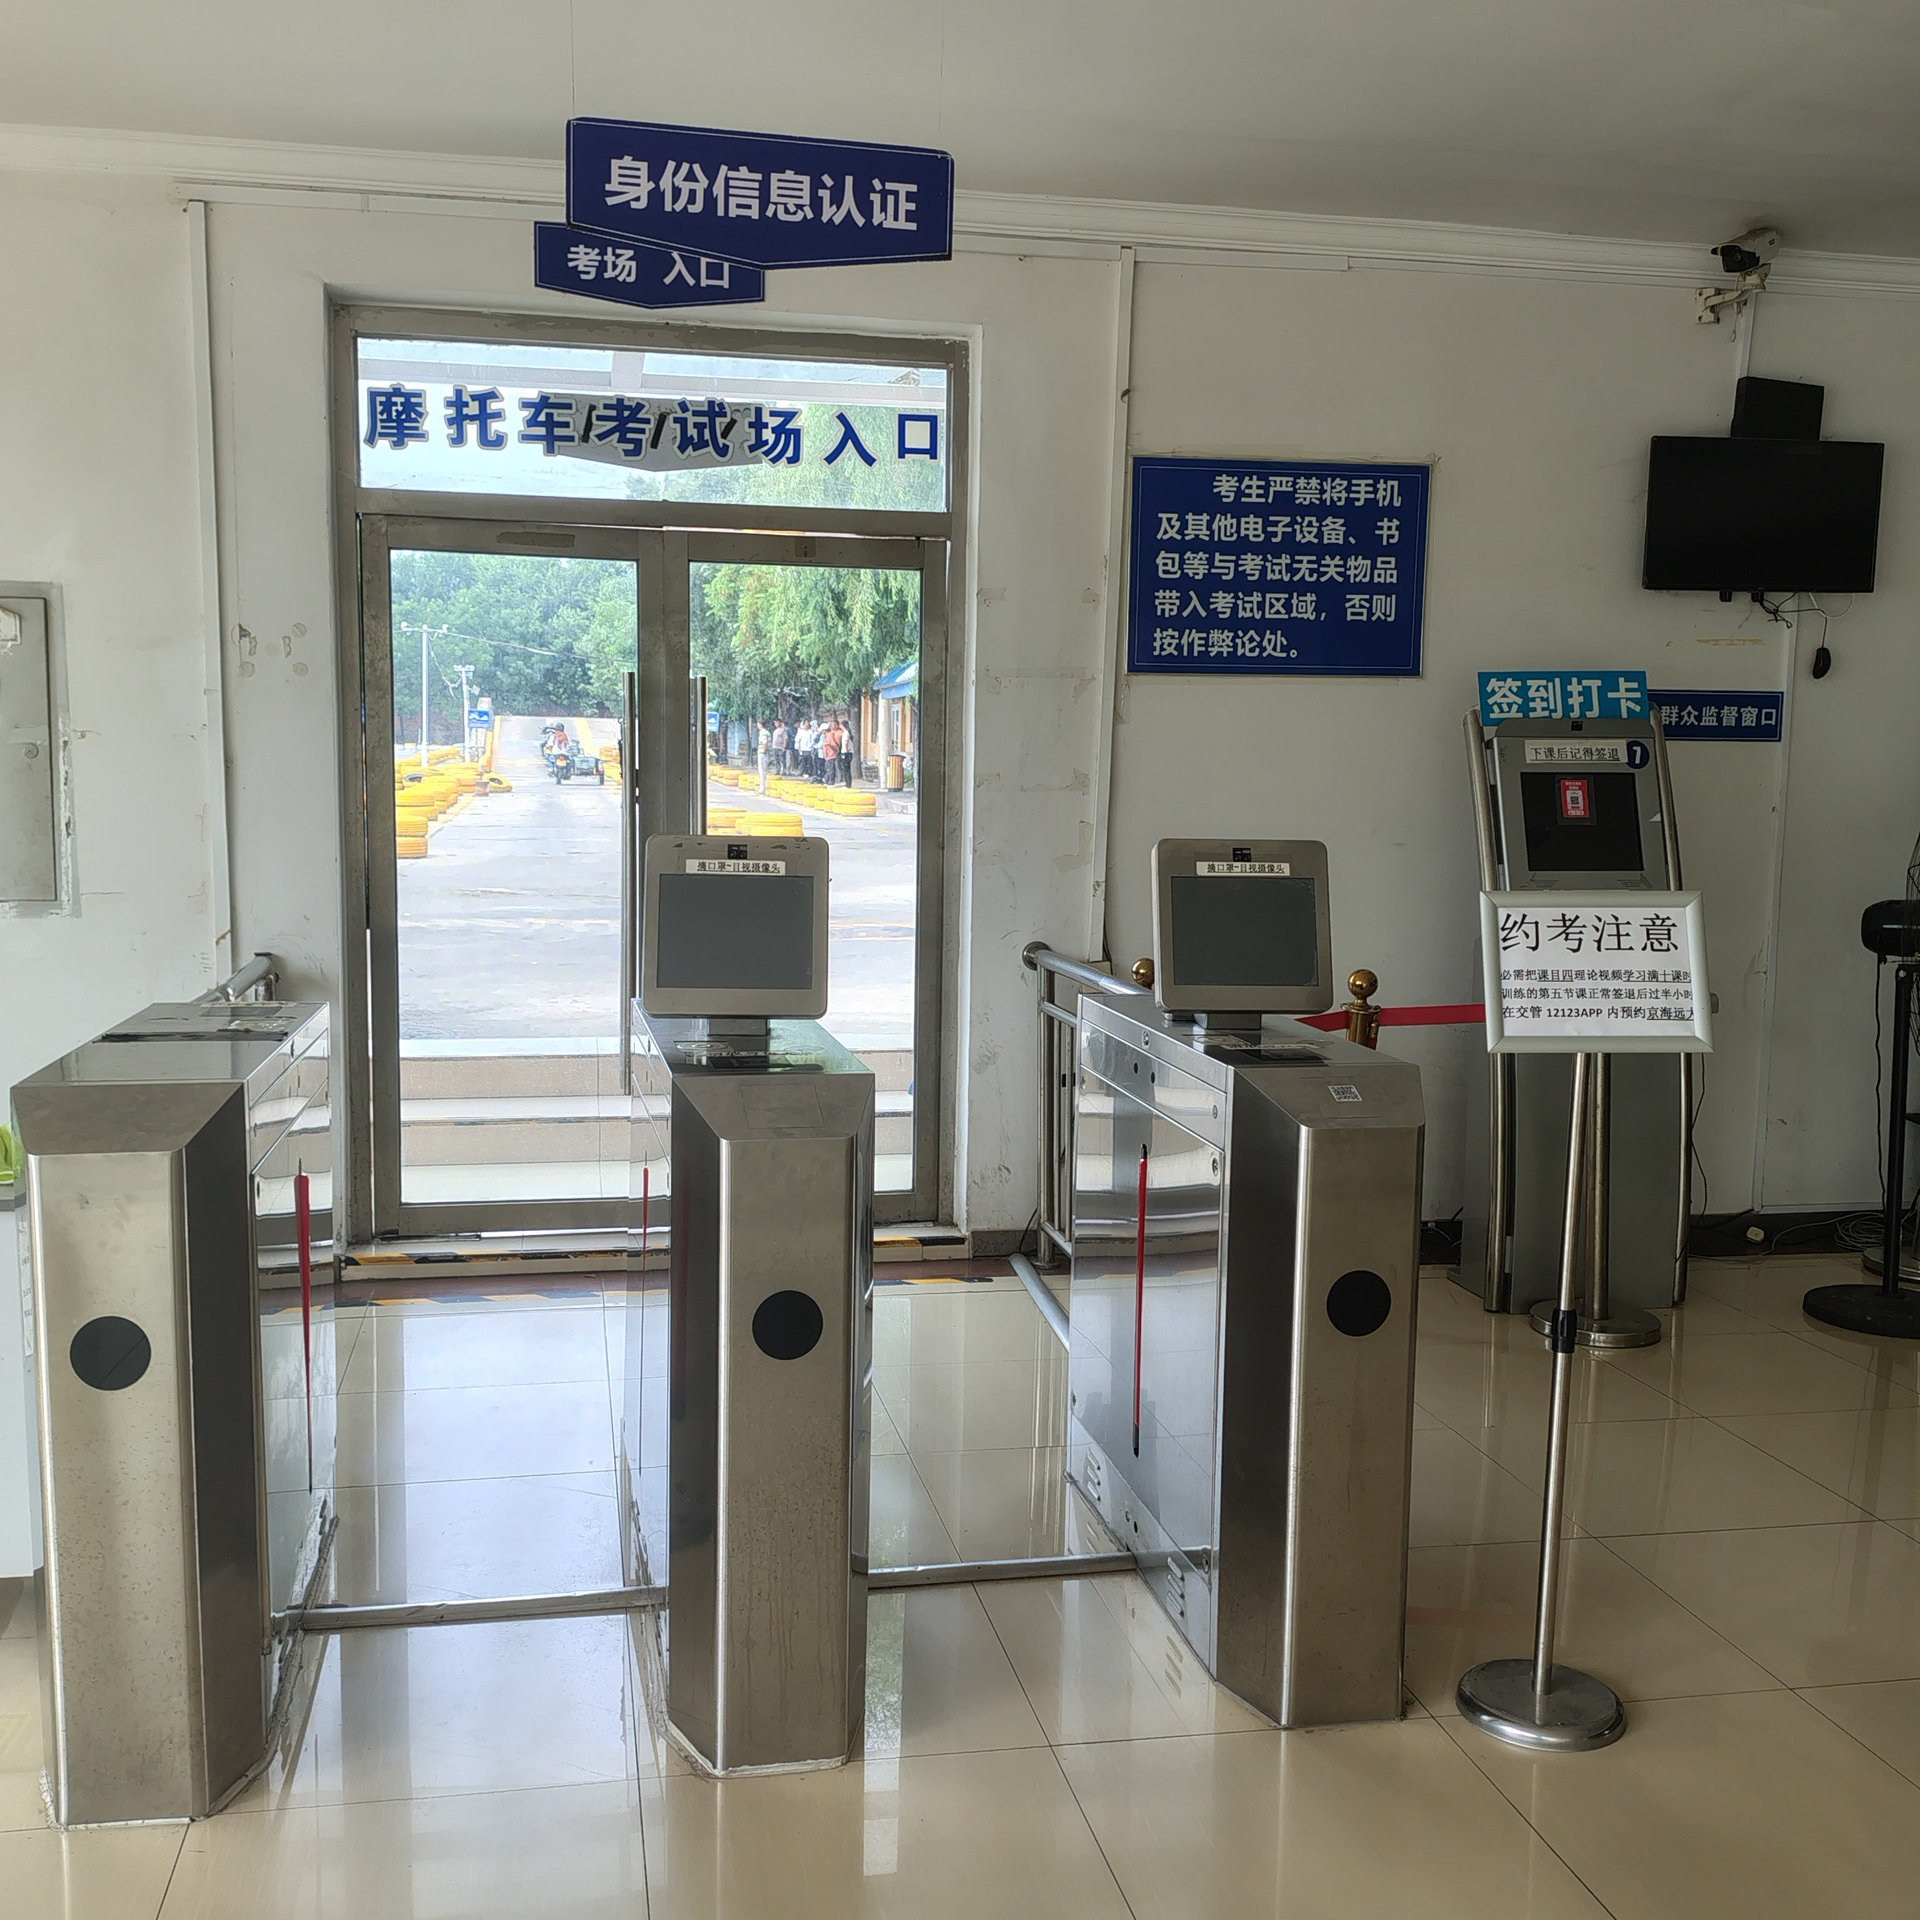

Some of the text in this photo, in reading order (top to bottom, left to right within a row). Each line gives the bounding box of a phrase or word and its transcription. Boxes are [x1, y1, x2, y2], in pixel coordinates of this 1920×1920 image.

[604, 155, 919, 231] 身份信息认证
[567, 244, 730, 289] 考场 入口
[364, 385, 941, 467] 摩托车考试场入口
[1213, 474, 1402, 507] 考生严禁将手机
[1156, 512, 1400, 546] 及其他电子设备、书
[1155, 550, 1398, 584] 包等与考试无关物品
[1154, 589, 1396, 622] 带入考试区域，否则
[1153, 628, 1300, 658] 按作弊论处。
[1485, 677, 1642, 719] 签到打卡
[1660, 705, 1777, 727] 群众监督窗口
[1530, 746, 1620, 760] 下课后记得签退
[1499, 912, 1679, 953] 约考注意
[1502, 1005, 1542, 1019] 在交管
[1547, 1007, 1603, 1018] 12123APP
